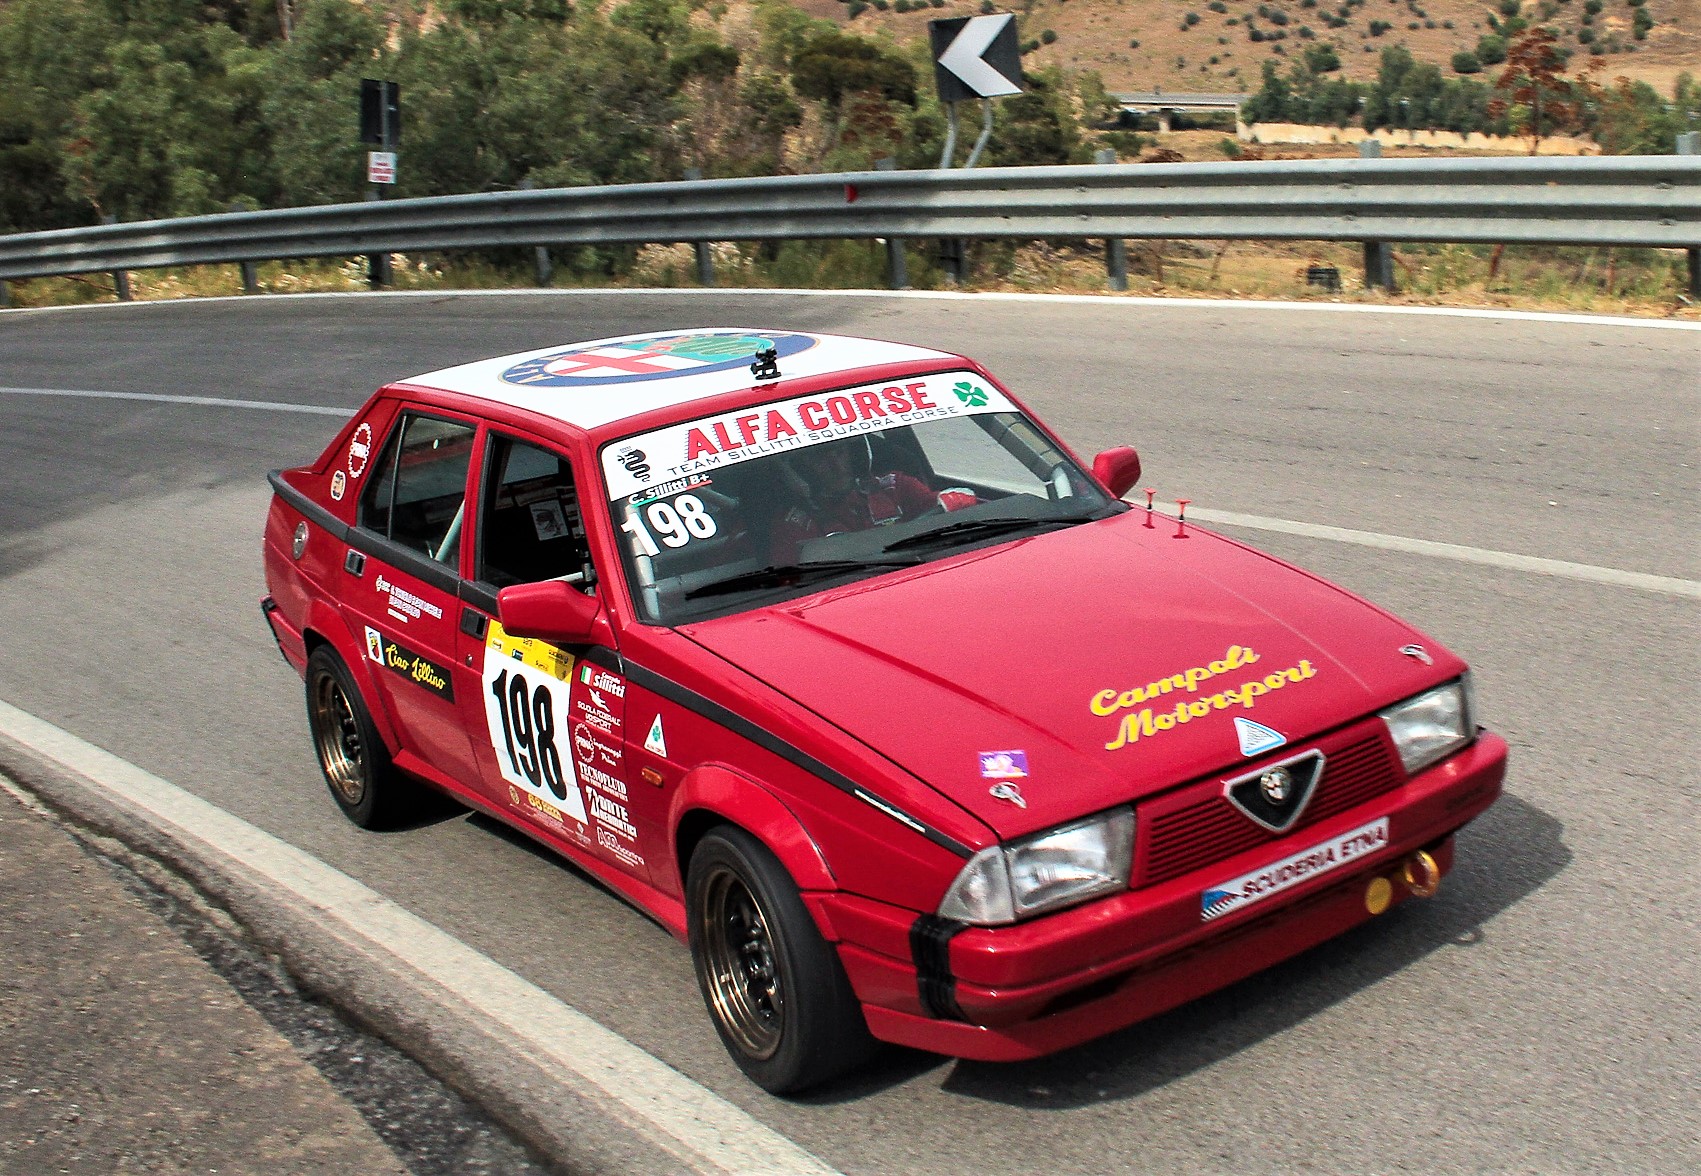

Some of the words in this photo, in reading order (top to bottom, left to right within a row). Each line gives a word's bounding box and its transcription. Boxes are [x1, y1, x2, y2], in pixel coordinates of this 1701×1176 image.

[666, 455, 721, 477] TEAM
[728, 436, 802, 460] SILLITTI
[808, 417, 894, 441] SQUADRA
[900, 405, 959, 423] CORSE
[684, 409, 797, 462] ALFA
[797, 381, 937, 431] CORSE
[646, 477, 688, 499] Sillitti
[620, 494, 718, 557] 198
[385, 643, 410, 671] Ciao
[592, 674, 626, 698] Sillitti
[492, 668, 567, 801] 198
[1105, 660, 1317, 750] Motorsport
[577, 760, 628, 796] TECNOFLUID
[1242, 848, 1336, 899] SCUDERIA
[1341, 825, 1388, 858] ETNA
